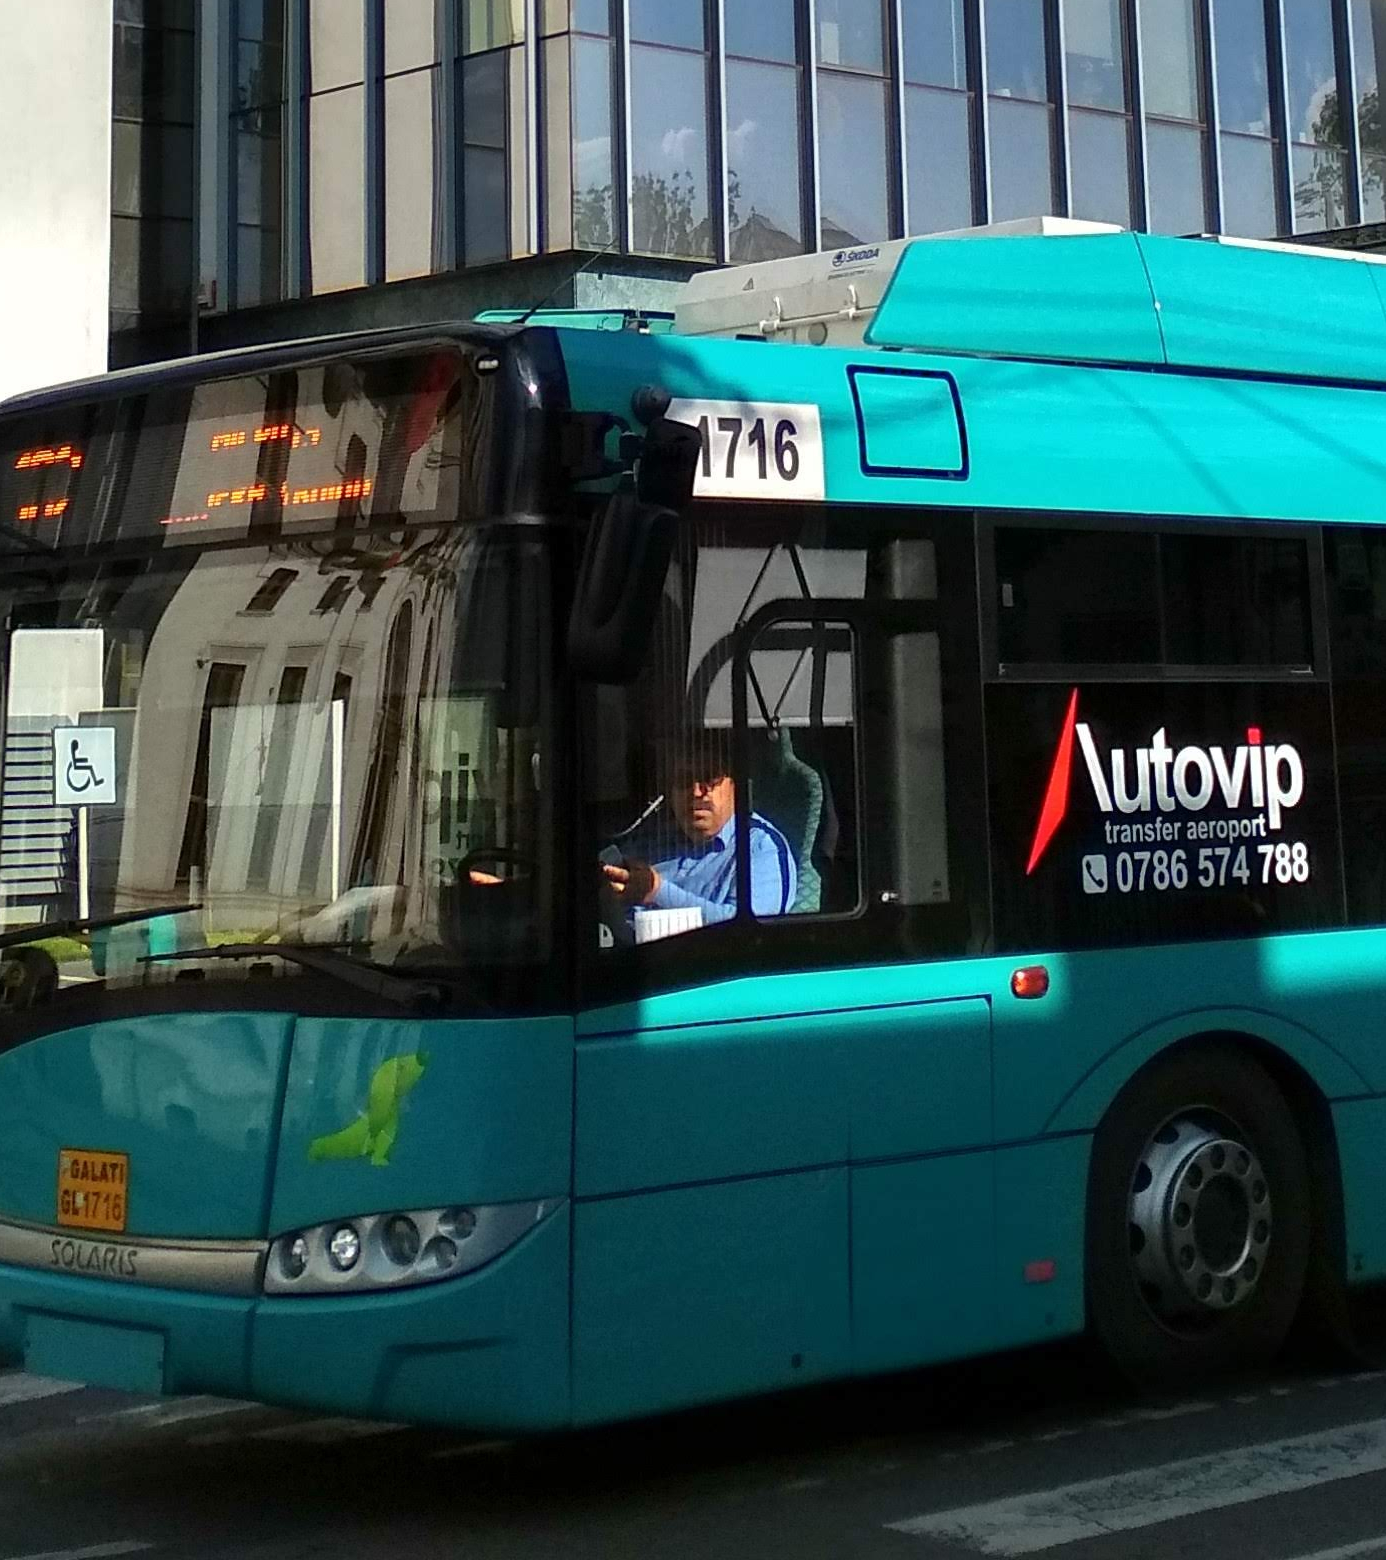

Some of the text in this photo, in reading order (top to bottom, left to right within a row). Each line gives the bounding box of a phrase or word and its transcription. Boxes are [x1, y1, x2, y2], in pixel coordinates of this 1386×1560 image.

[697, 415, 800, 481] 1716
[1026, 687, 1305, 876] Autovip
[1105, 813, 1267, 845] transfer aeroport
[1116, 842, 1309, 893] 0786 574 788
[51, 1239, 138, 1276] SOLARIS
